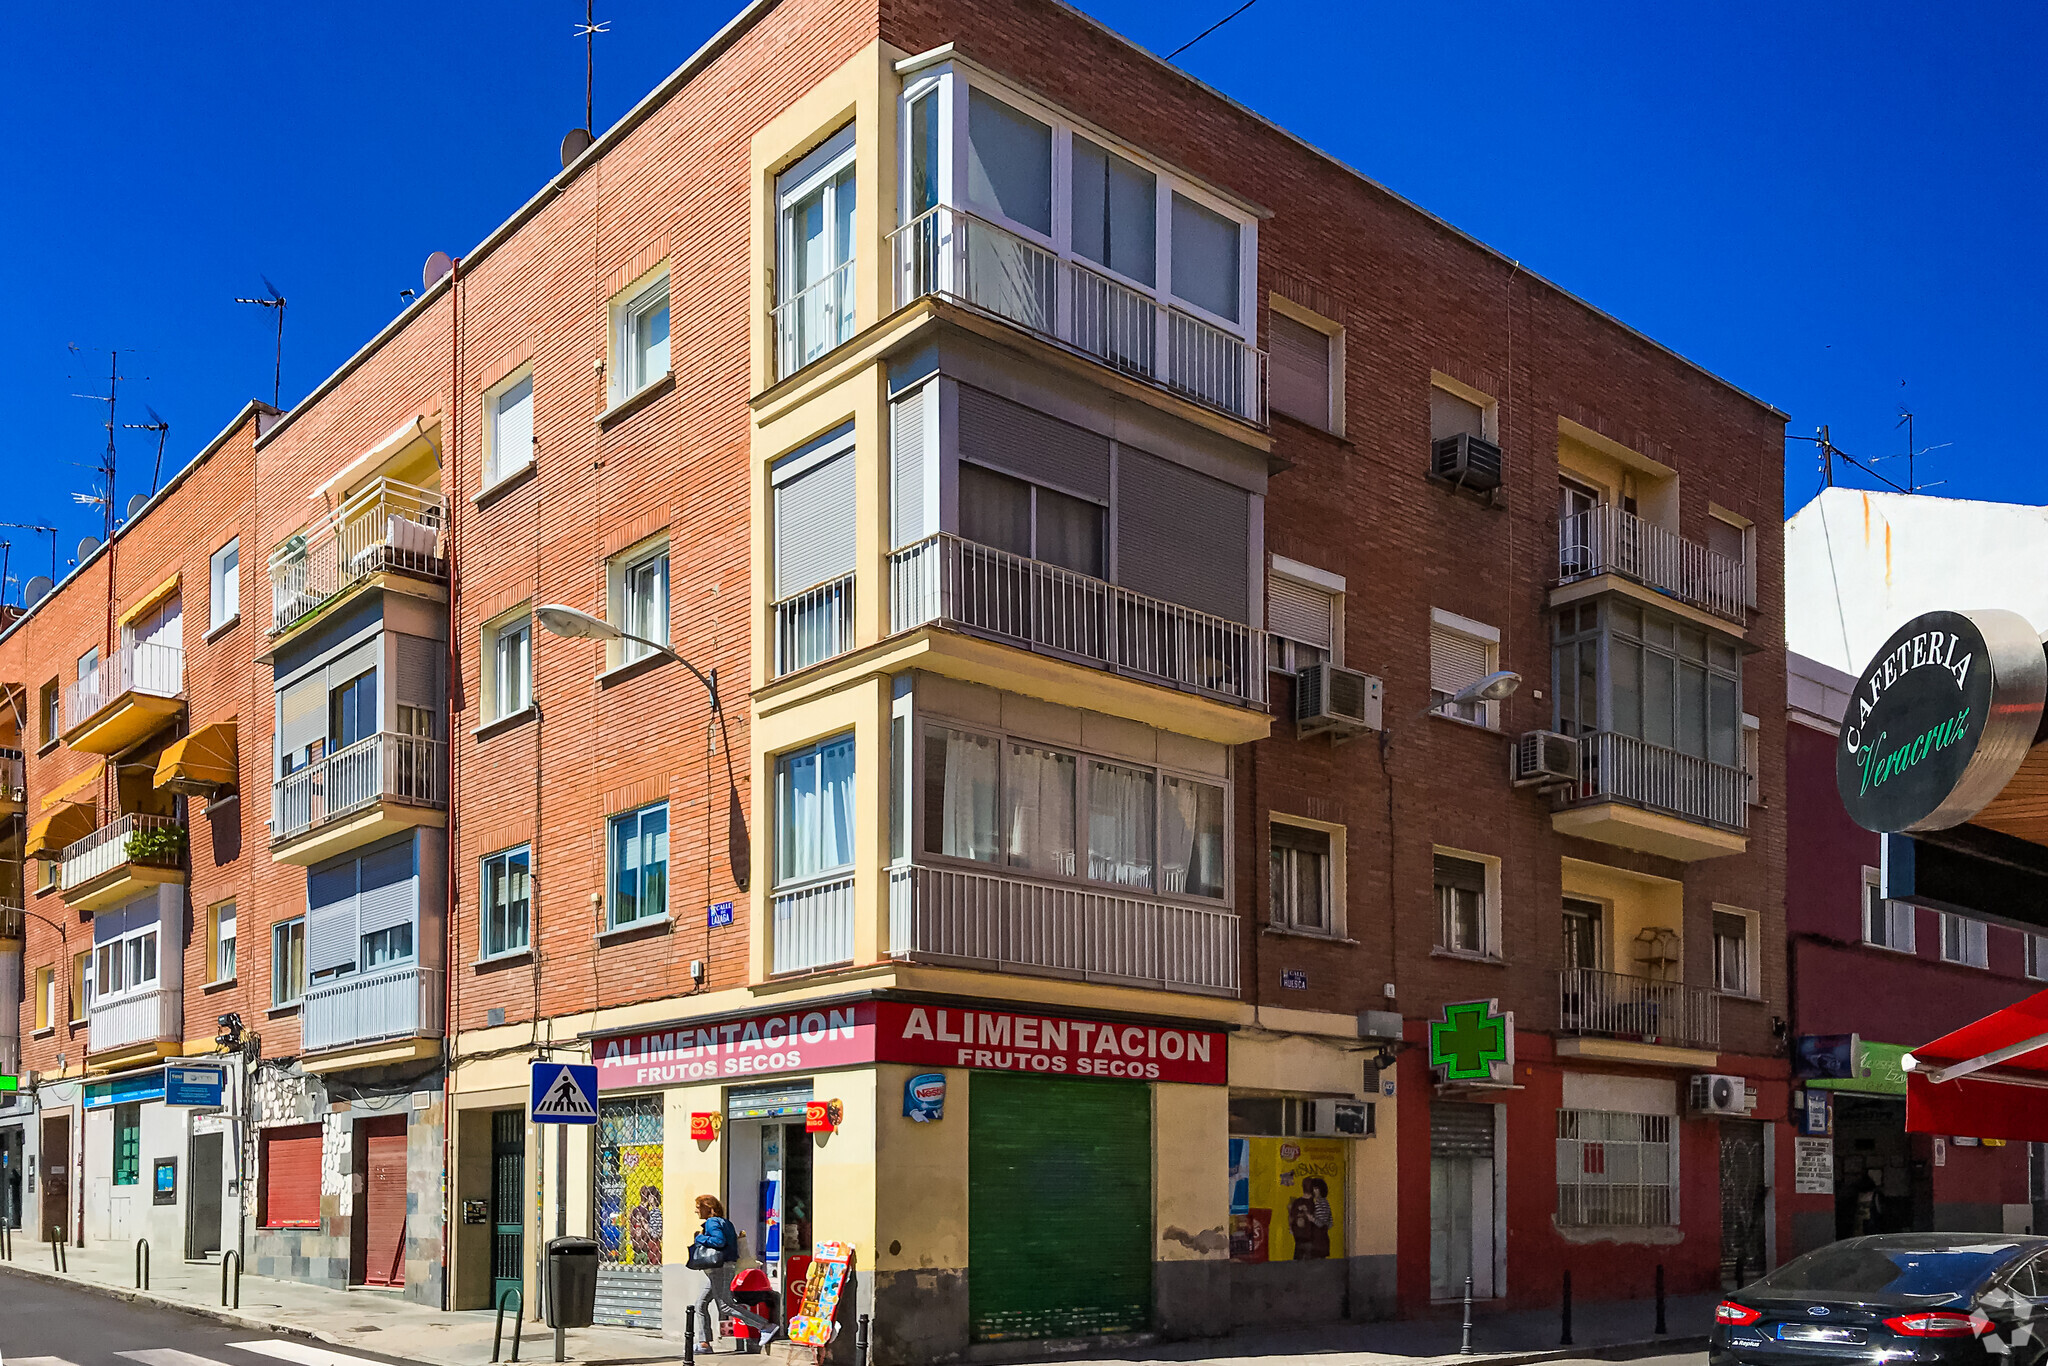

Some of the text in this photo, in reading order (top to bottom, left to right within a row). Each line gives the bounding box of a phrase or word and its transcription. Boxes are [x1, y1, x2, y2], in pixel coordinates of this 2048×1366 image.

[1846, 631, 1973, 754] CAFETERIA
[1857, 707, 1970, 797] Veracruz
[1284, 979, 1305, 989] HUESCA
[603, 1007, 855, 1069] ALIMENTACION
[902, 1007, 1211, 1063] ALIMENTACION
[636, 1051, 801, 1083] FRUTOS SECOS
[957, 1048, 1160, 1079] FRUTOS SECOS
